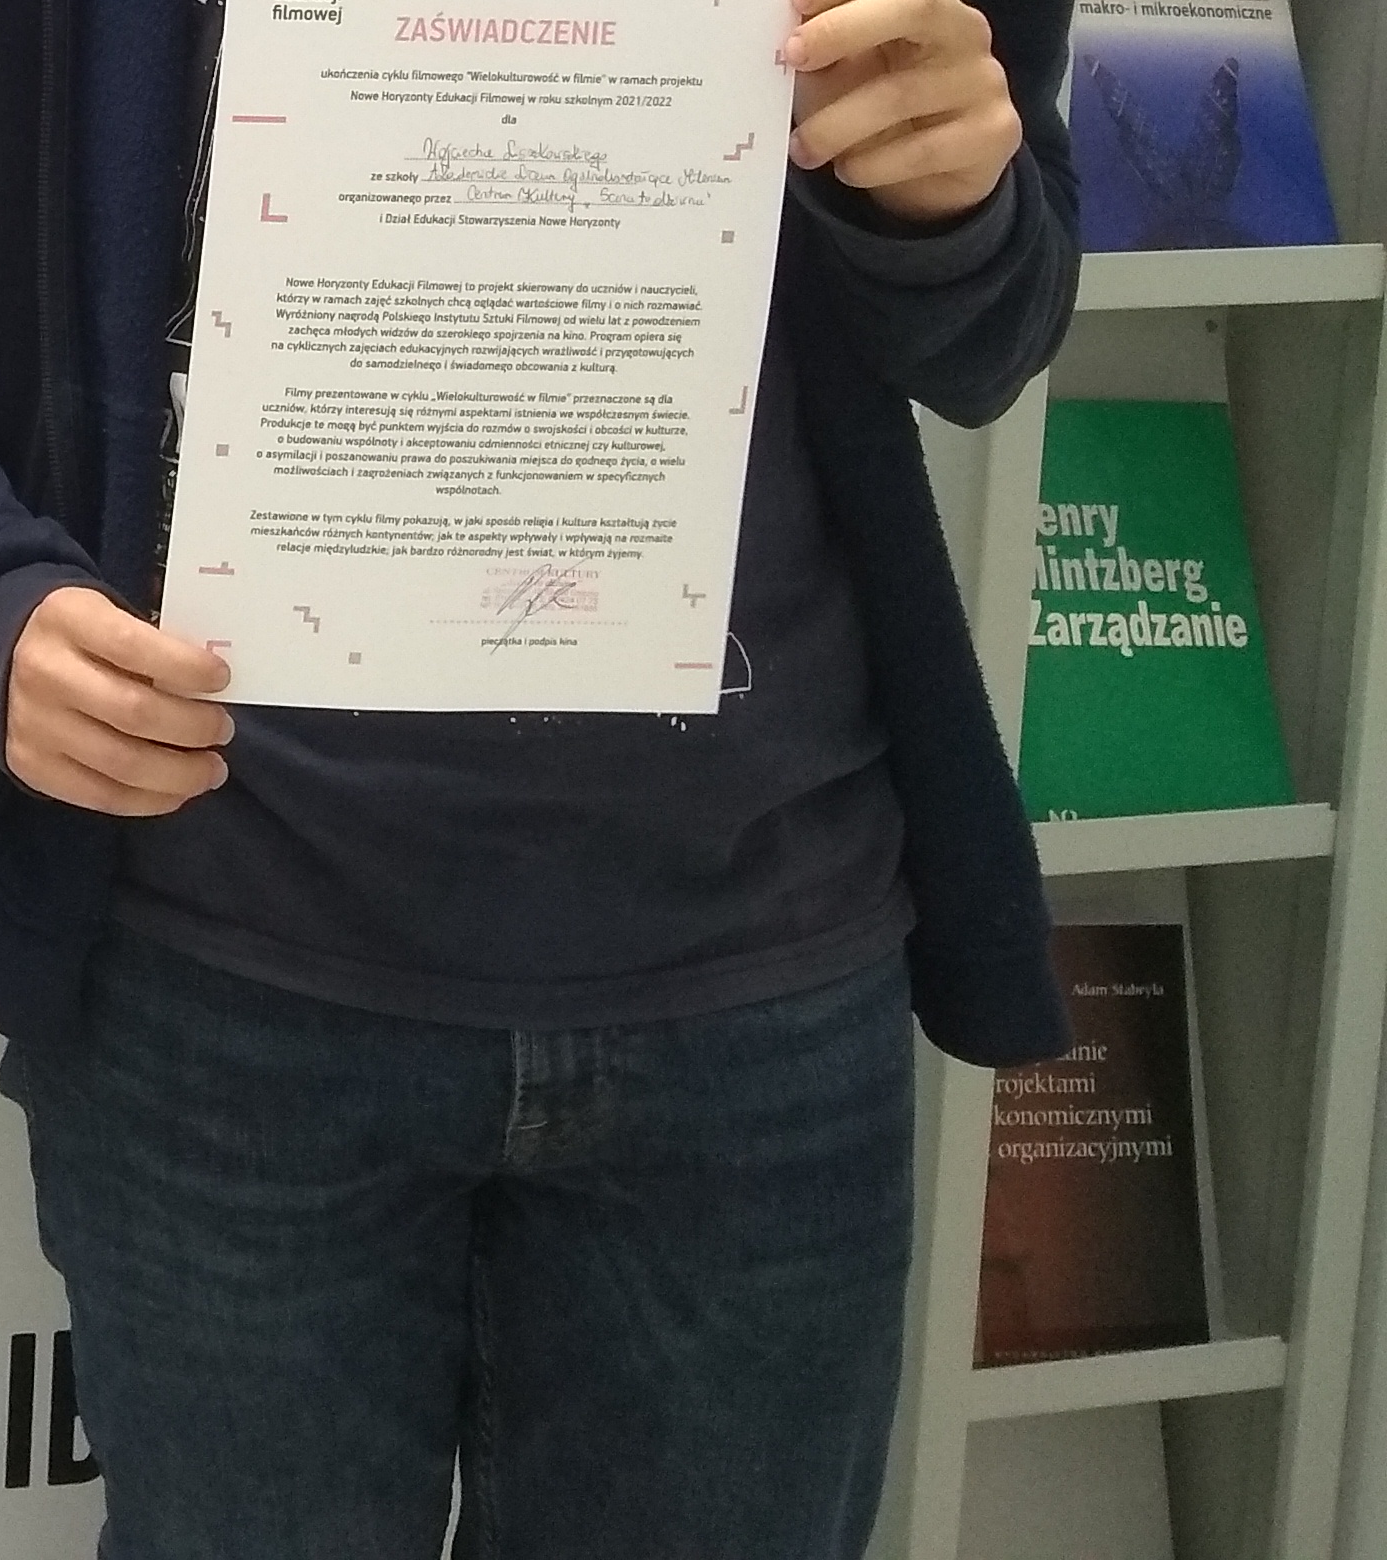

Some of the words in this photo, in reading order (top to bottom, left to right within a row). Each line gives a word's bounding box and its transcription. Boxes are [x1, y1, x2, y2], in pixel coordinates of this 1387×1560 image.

[272, 4, 343, 25] filmowej
[1080, 0, 1130, 15] makro-
[1133, 1, 1137, 15] i
[1141, 2, 1273, 20] mikroekonomiczne
[394, 11, 617, 45] ZAŚWIADCZENIE
[319, 67, 381, 81] ukończenia
[381, 68, 410, 83] cyklu
[410, 69, 465, 85] filmowego
[465, 70, 560, 84] "Wielokulturowość
[560, 74, 572, 84] w
[572, 71, 607, 85] filmie"
[607, 76, 619, 85] w
[618, 74, 659, 86] ramach
[659, 75, 704, 89] projektu
[1037, 501, 1119, 547] enry
[1027, 600, 1249, 658] Zarządzanie
[1072, 982, 1108, 997] Adam
[995, 1072, 1096, 1100] rojektami
[994, 1104, 1153, 1131] konomicznymi
[998, 1135, 1173, 1165] organizacyjnymi
